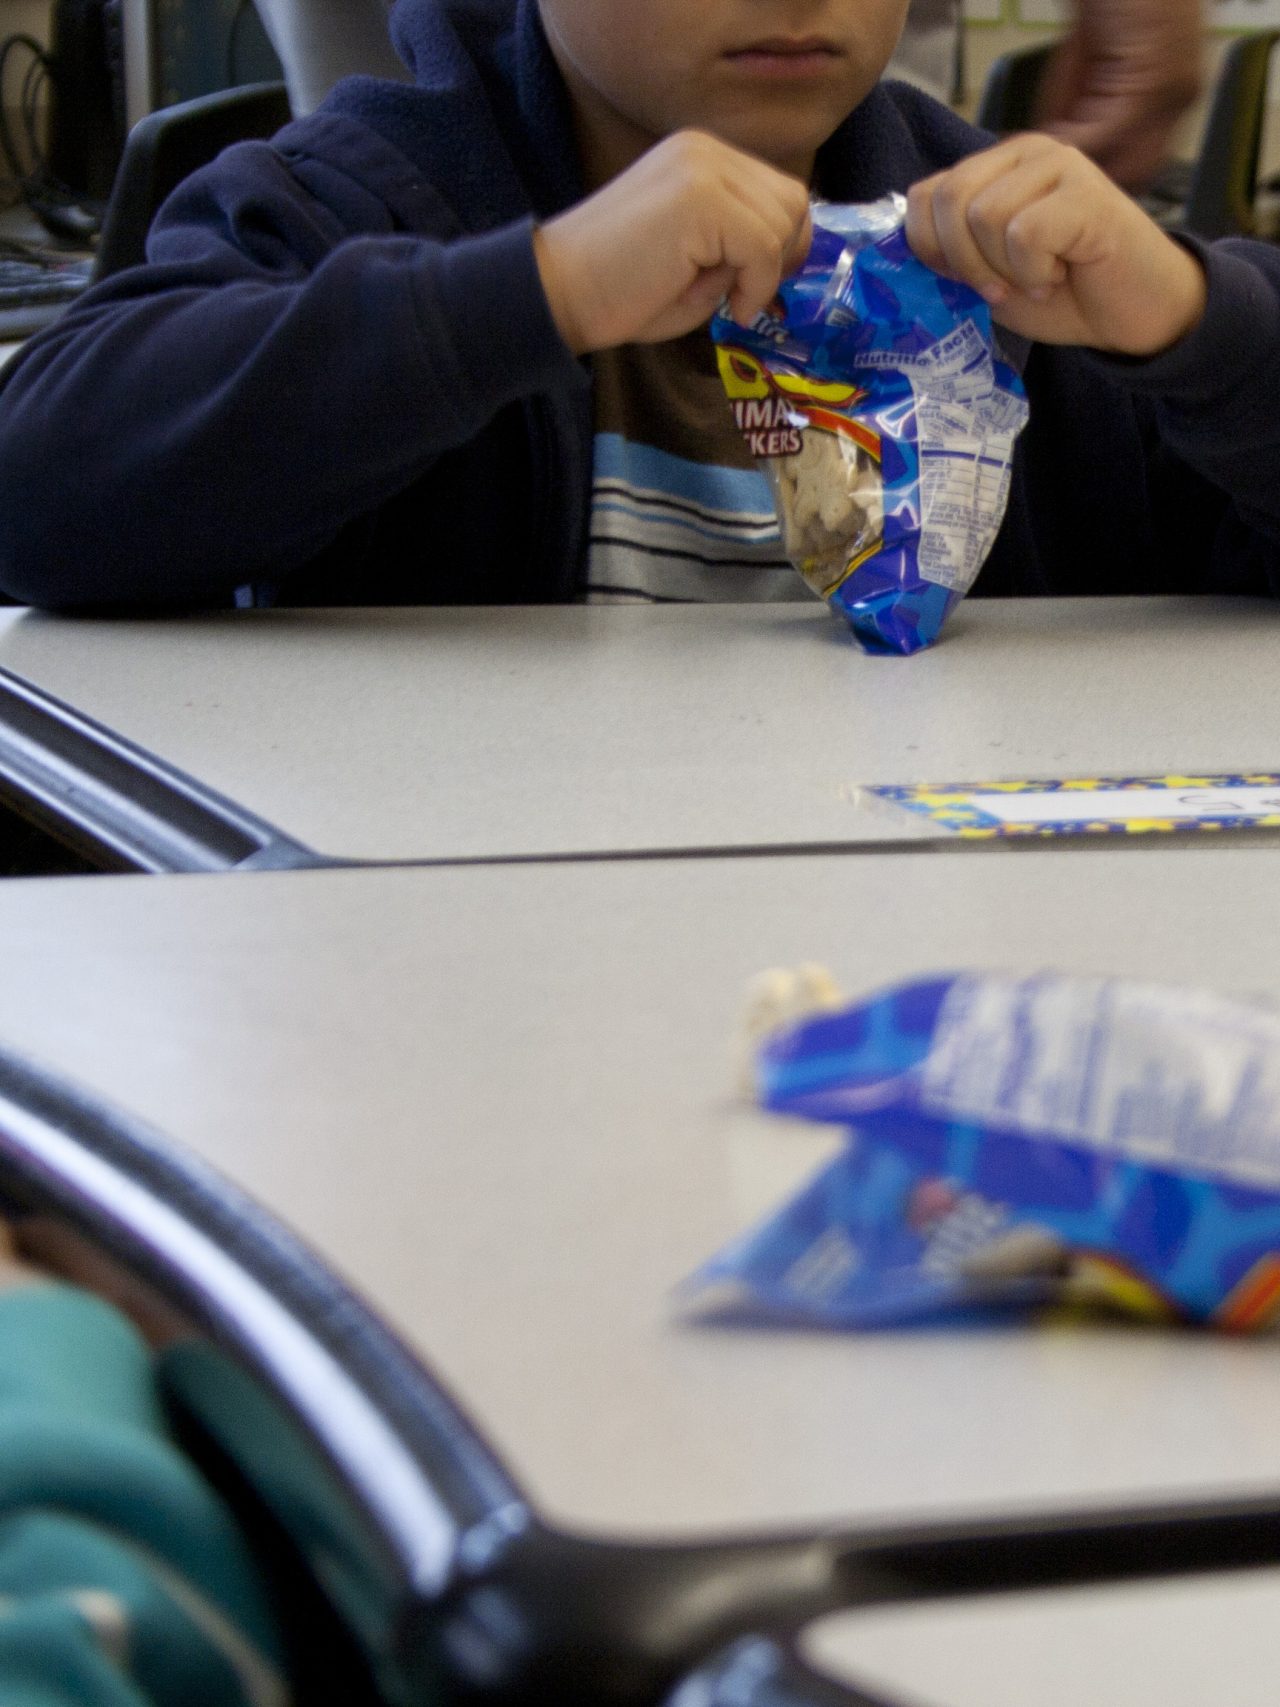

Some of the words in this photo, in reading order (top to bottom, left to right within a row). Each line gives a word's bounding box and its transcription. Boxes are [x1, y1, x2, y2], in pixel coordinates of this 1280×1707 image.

[931, 323, 975, 360] Facts
[730, 397, 802, 429] IMA
[743, 430, 801, 456] KERS
